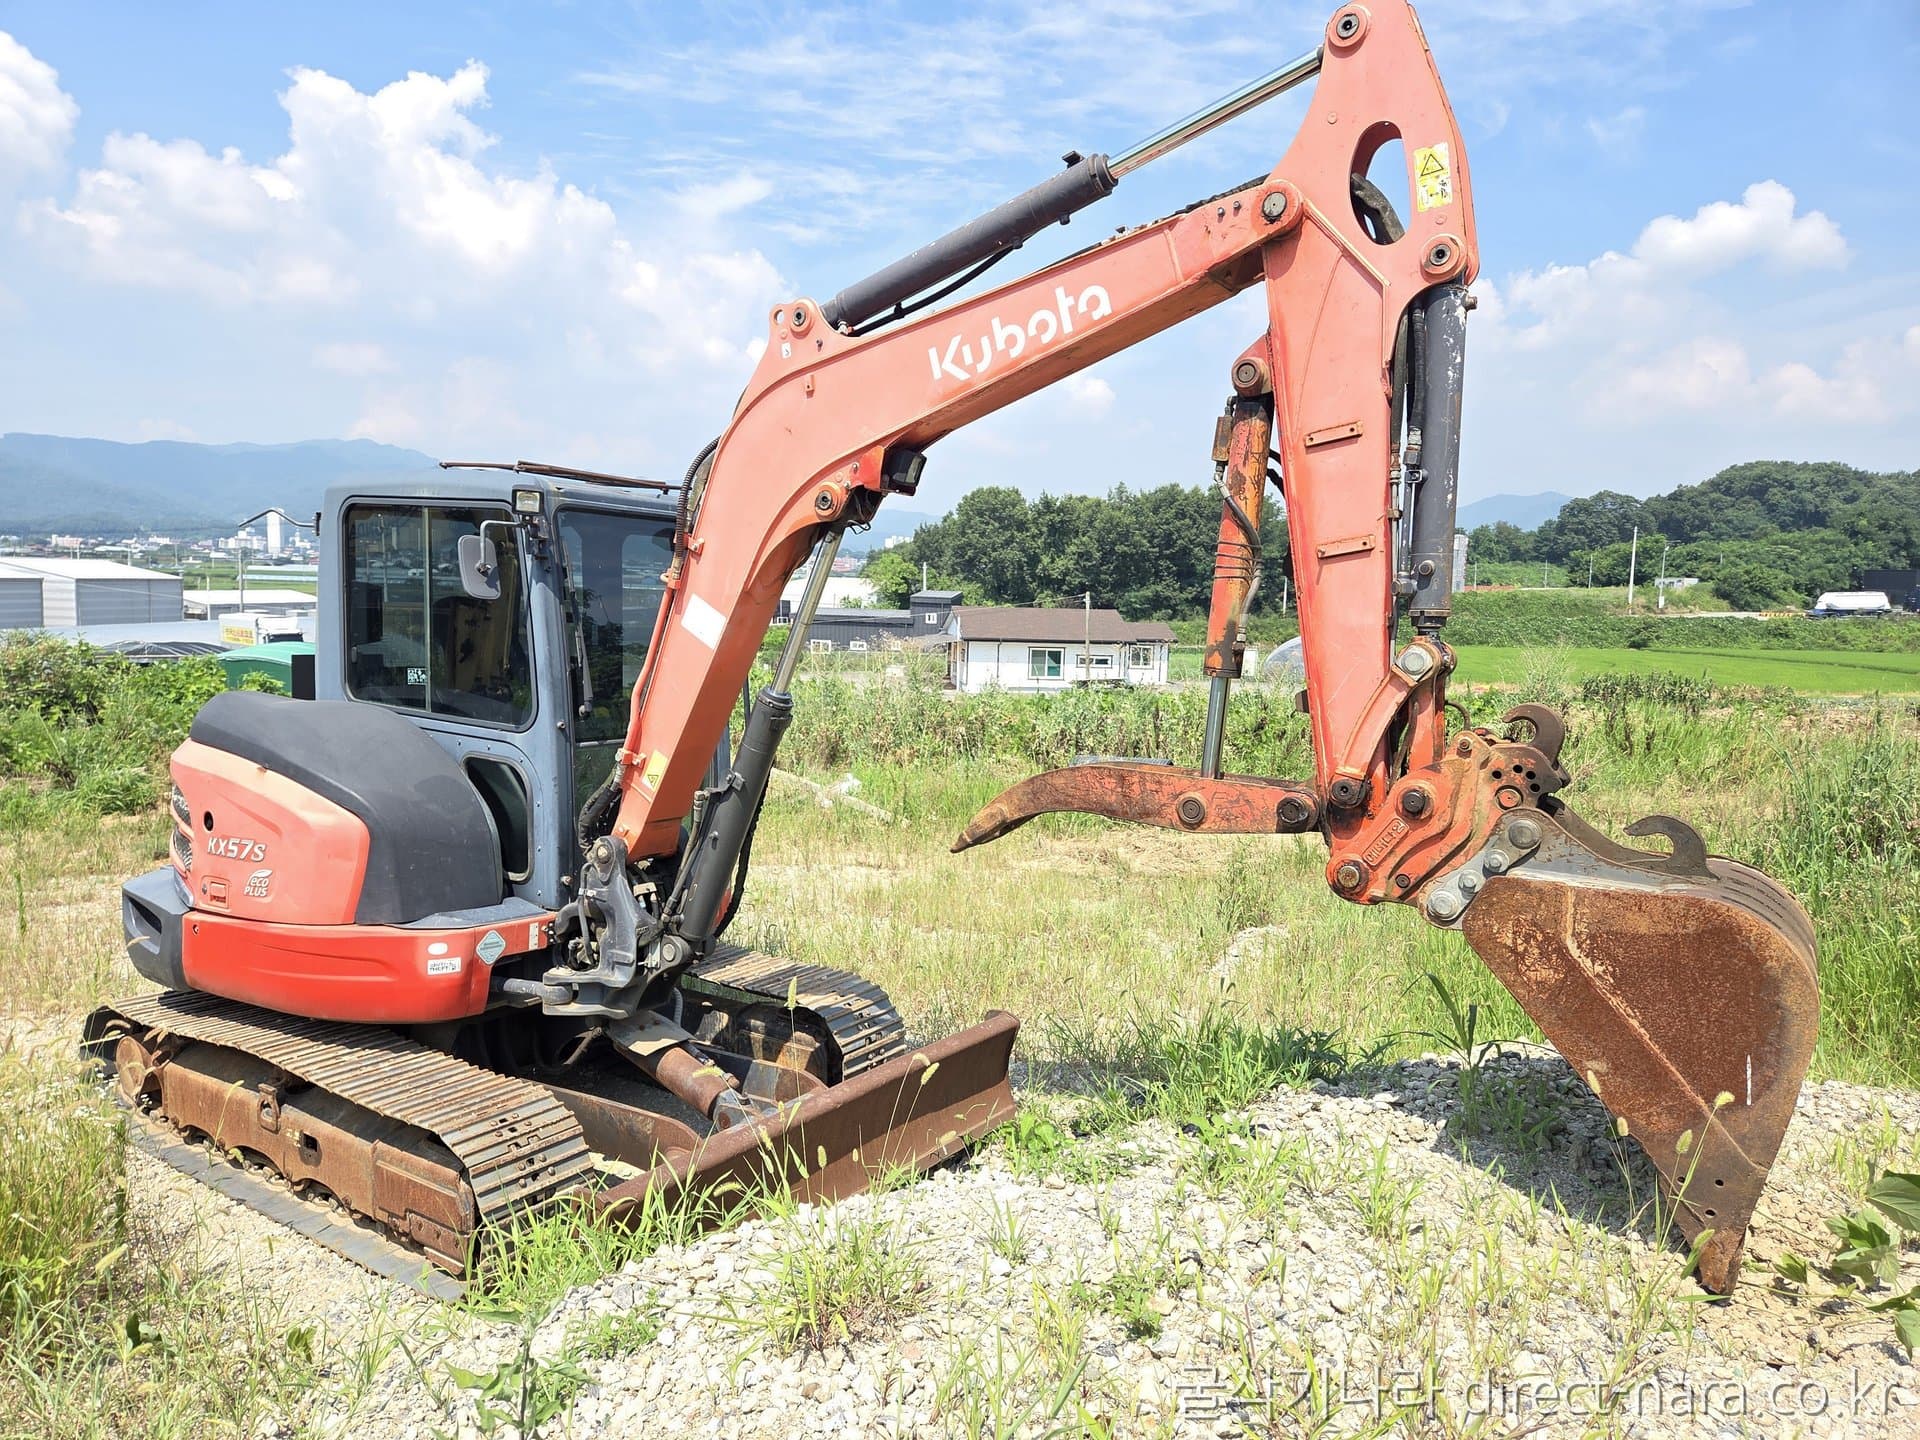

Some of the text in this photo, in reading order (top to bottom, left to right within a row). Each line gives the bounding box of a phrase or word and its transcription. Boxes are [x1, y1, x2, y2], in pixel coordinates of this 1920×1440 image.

[928, 285, 1112, 381] Kubota
[207, 836, 267, 862] KX57S
[244, 886, 268, 897] PLUS
